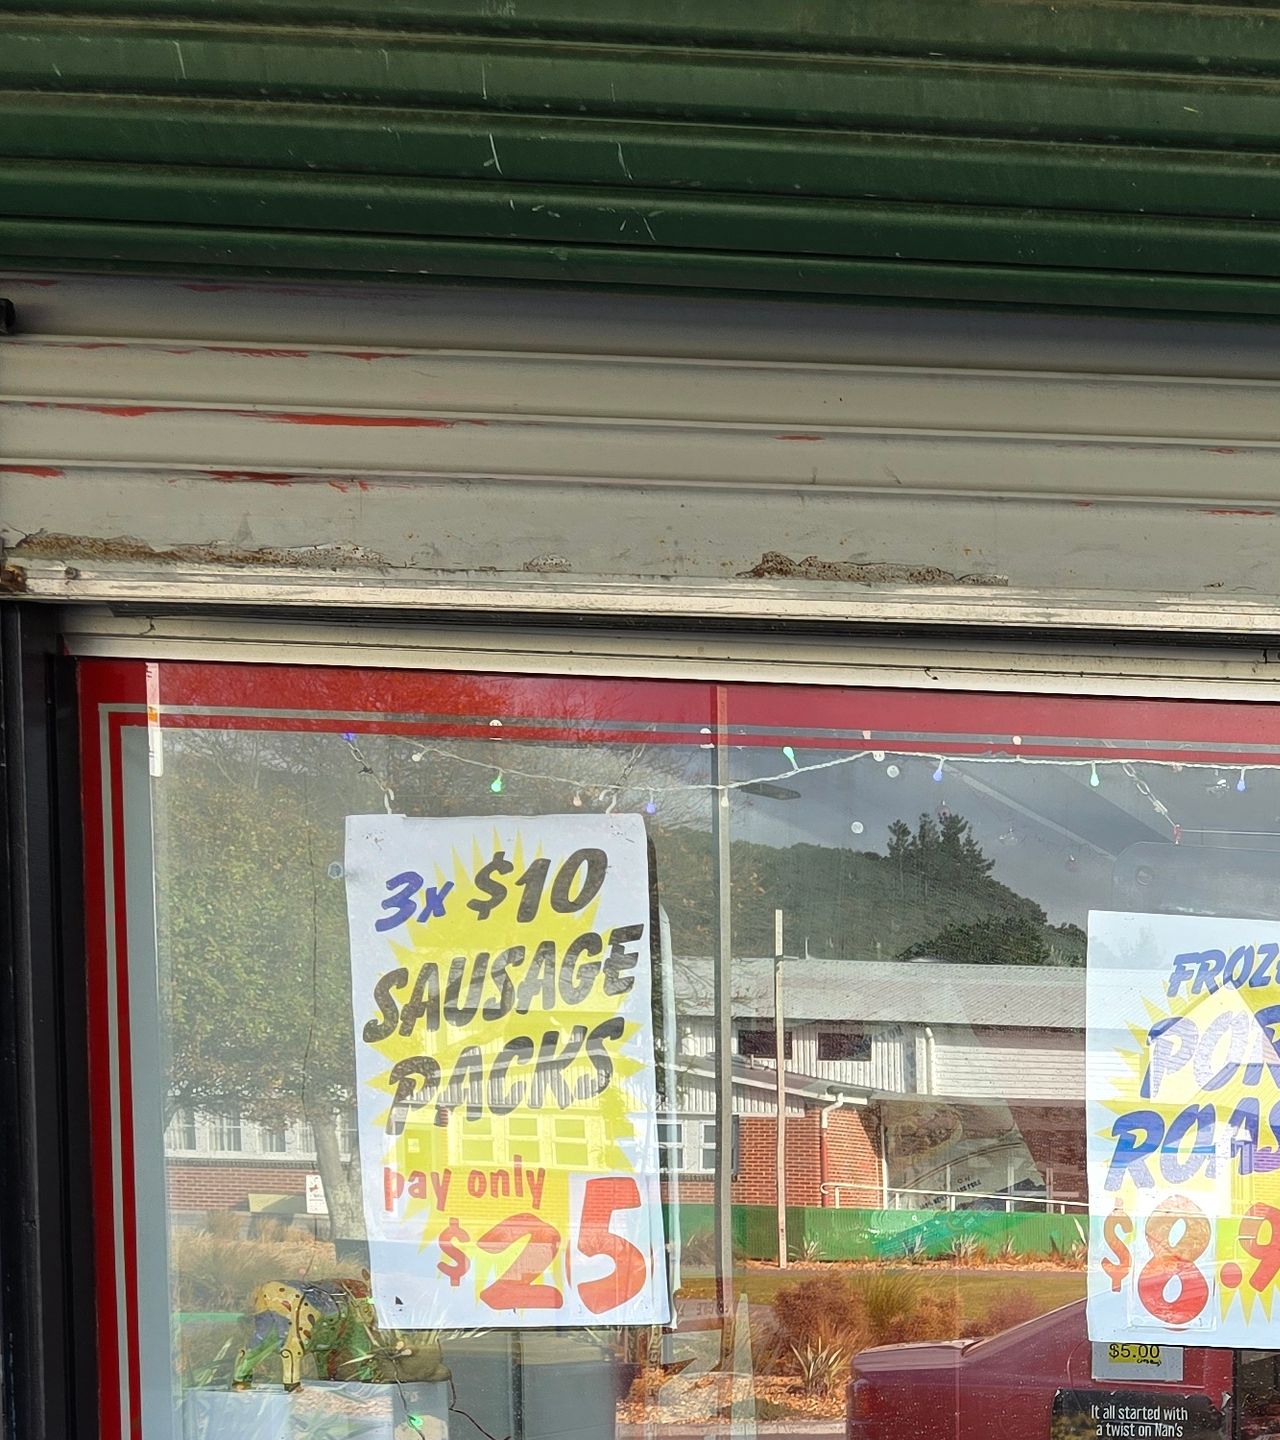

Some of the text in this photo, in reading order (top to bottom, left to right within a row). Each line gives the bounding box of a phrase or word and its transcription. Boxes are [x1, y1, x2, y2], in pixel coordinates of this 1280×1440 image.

[466, 847, 609, 924] $10
[363, 923, 644, 1044] SAUSAGE
[387, 1017, 626, 1136] PACKS
[383, 1155, 545, 1211] pay only
[437, 1176, 652, 1315] $25
[1109, 1343, 1160, 1359] $5.00
[1091, 1405, 1188, 1421] It all started with
[1096, 1423, 1183, 1437] a twist on Nan's
